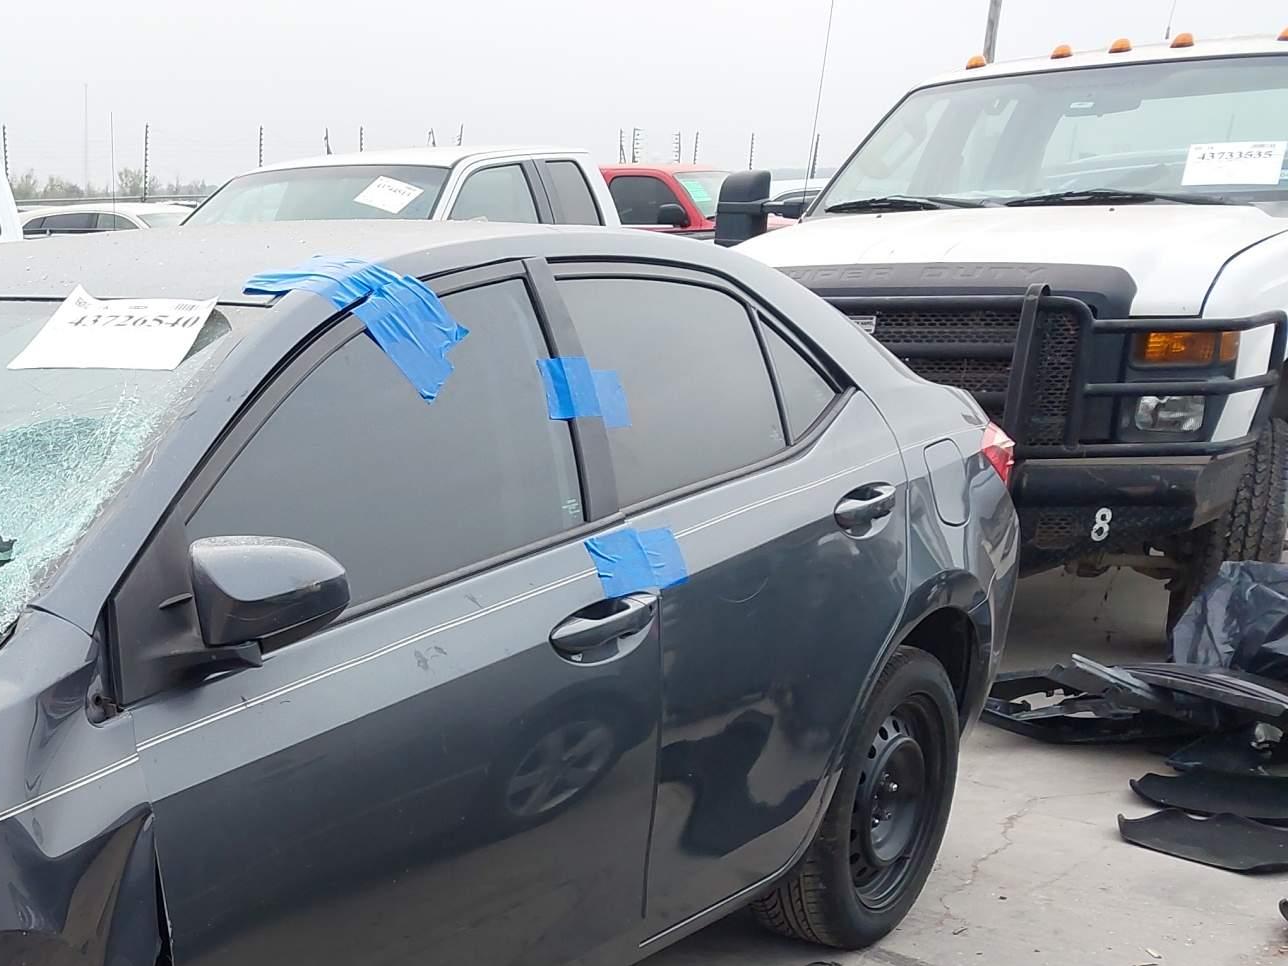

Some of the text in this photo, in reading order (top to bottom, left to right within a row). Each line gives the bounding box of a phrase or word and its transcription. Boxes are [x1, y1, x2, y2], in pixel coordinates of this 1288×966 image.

[1196, 151, 1273, 161] 43733535
[786, 265, 1049, 281] UPER DUTY
[68, 314, 200, 328] 43726540
[1091, 507, 1113, 542] 8
